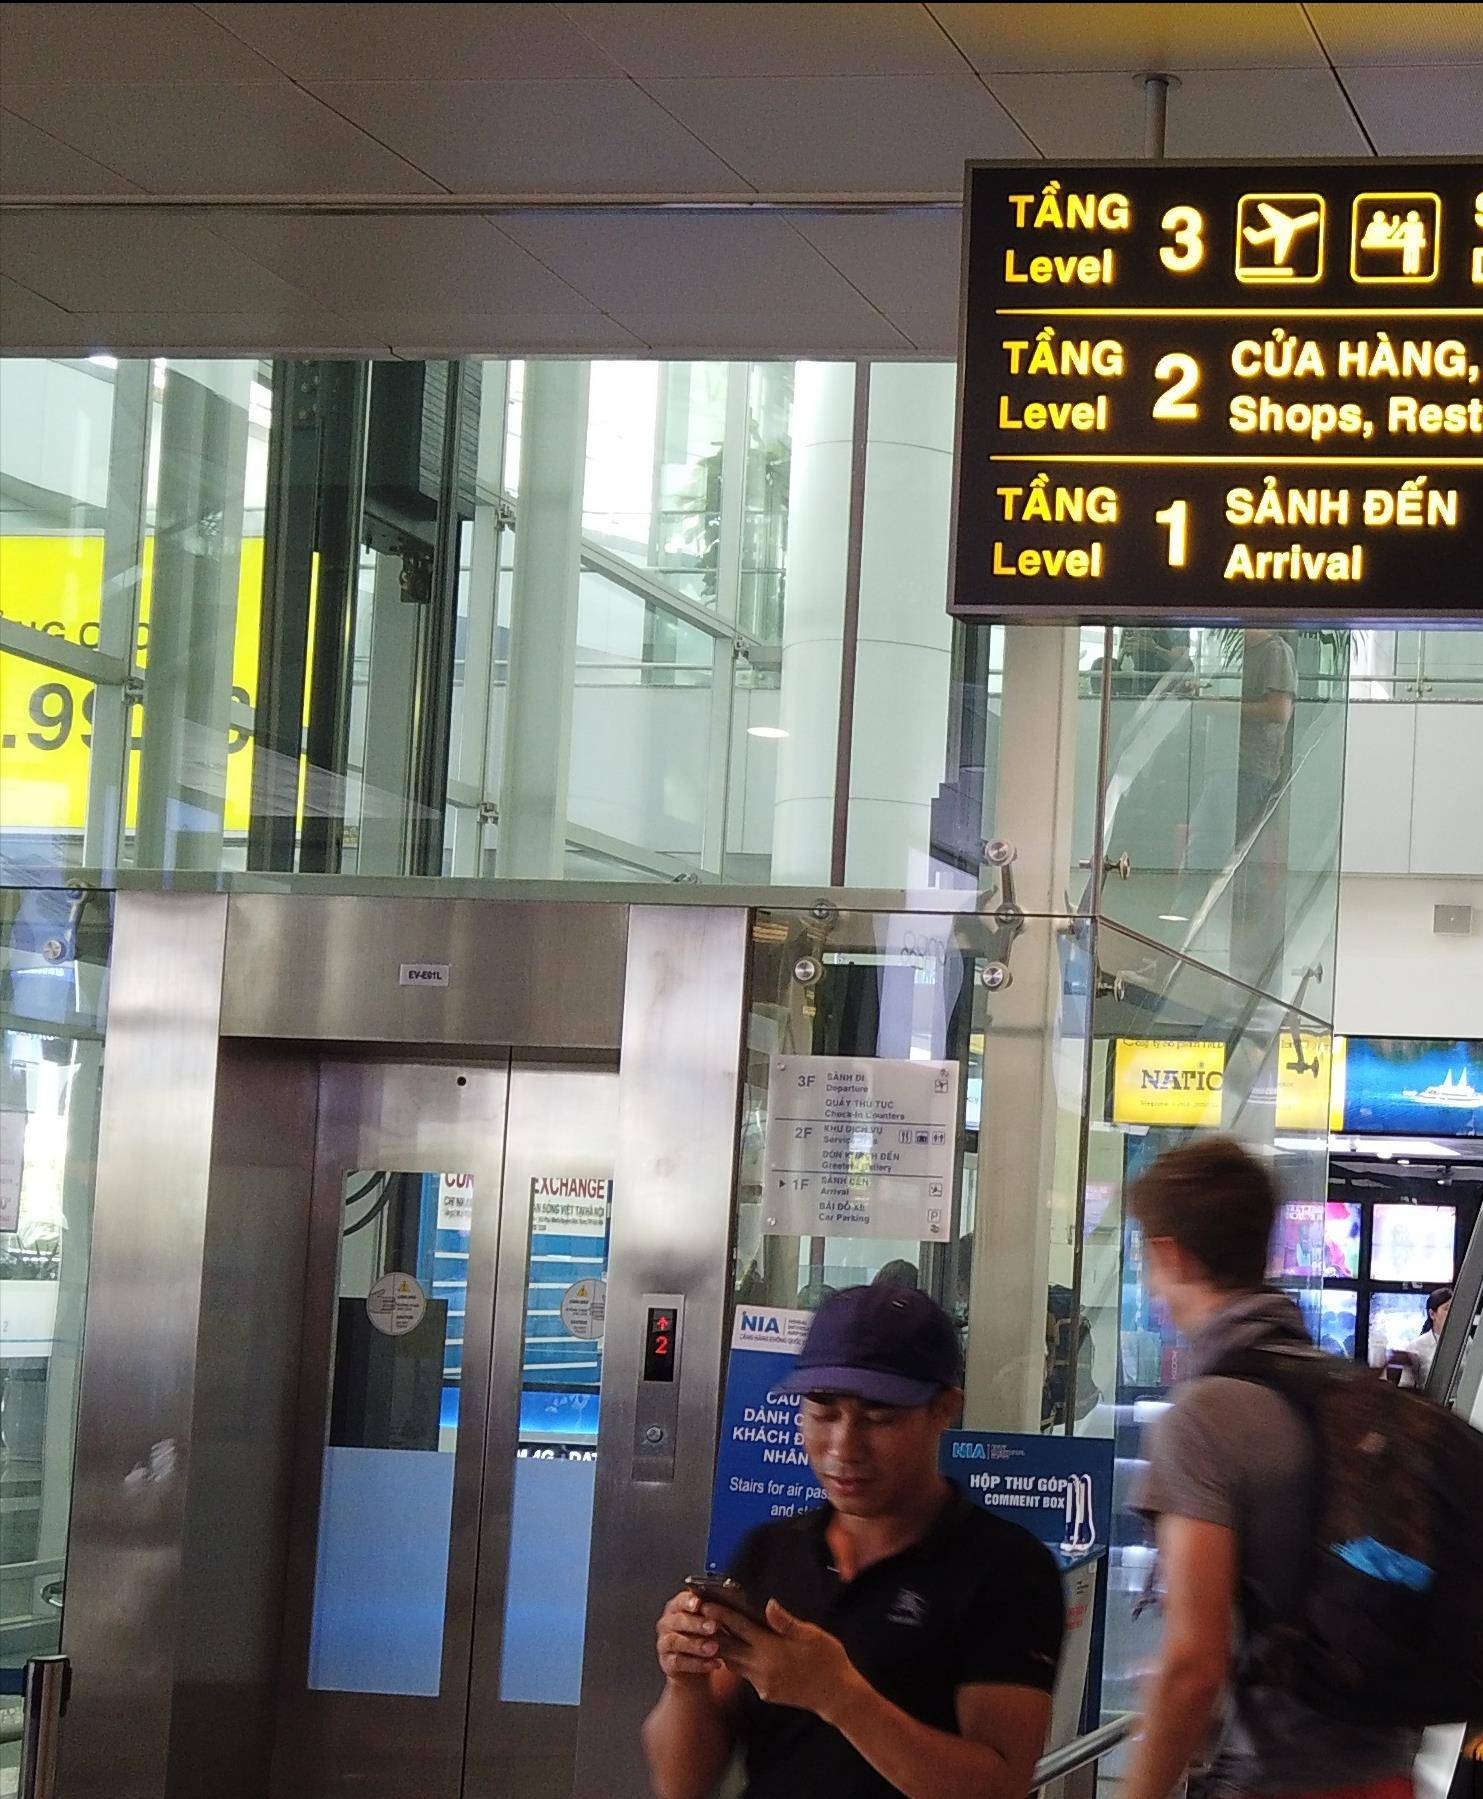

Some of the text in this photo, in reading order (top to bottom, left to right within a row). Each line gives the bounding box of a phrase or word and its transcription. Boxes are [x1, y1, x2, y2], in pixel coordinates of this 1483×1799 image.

[1009, 181, 1131, 230] TẦNG
[1160, 206, 1206, 273] 3
[1006, 249, 1115, 284] Level
[1003, 327, 1126, 378] TẦNG
[1232, 328, 1326, 379] CỬA
[1339, 332, 1480, 384] HÀNG,
[1153, 353, 1202, 421] 2
[1000, 396, 1109, 432] Level
[1230, 395, 1374, 442] Shops,
[997, 473, 1120, 524] TẦNG
[1226, 476, 1458, 526] SẢNH ĐẾN
[1156, 501, 1190, 568] 1
[994, 542, 1104, 577] Level
[1224, 544, 1363, 581] Arrival
[797, 1075, 816, 1088] 3F
[826, 1084, 869, 1093] Departure
[795, 1127, 813, 1140] 2F
[792, 1179, 810, 1190] 1F
[820, 1187, 849, 1196] Arrival
[818, 1213, 870, 1224] Car Parking
[741, 1311, 780, 1334] NIA
[655, 1336, 669, 1354] 2
[732, 1426, 790, 1445] KHÁCH
[729, 1476, 830, 1501] Stairs for air pas
[970, 1473, 1068, 1492] HỘP THƯ GÓP
[770, 1503, 794, 1517] and
[985, 1494, 1065, 1509] COMMENT BOX
